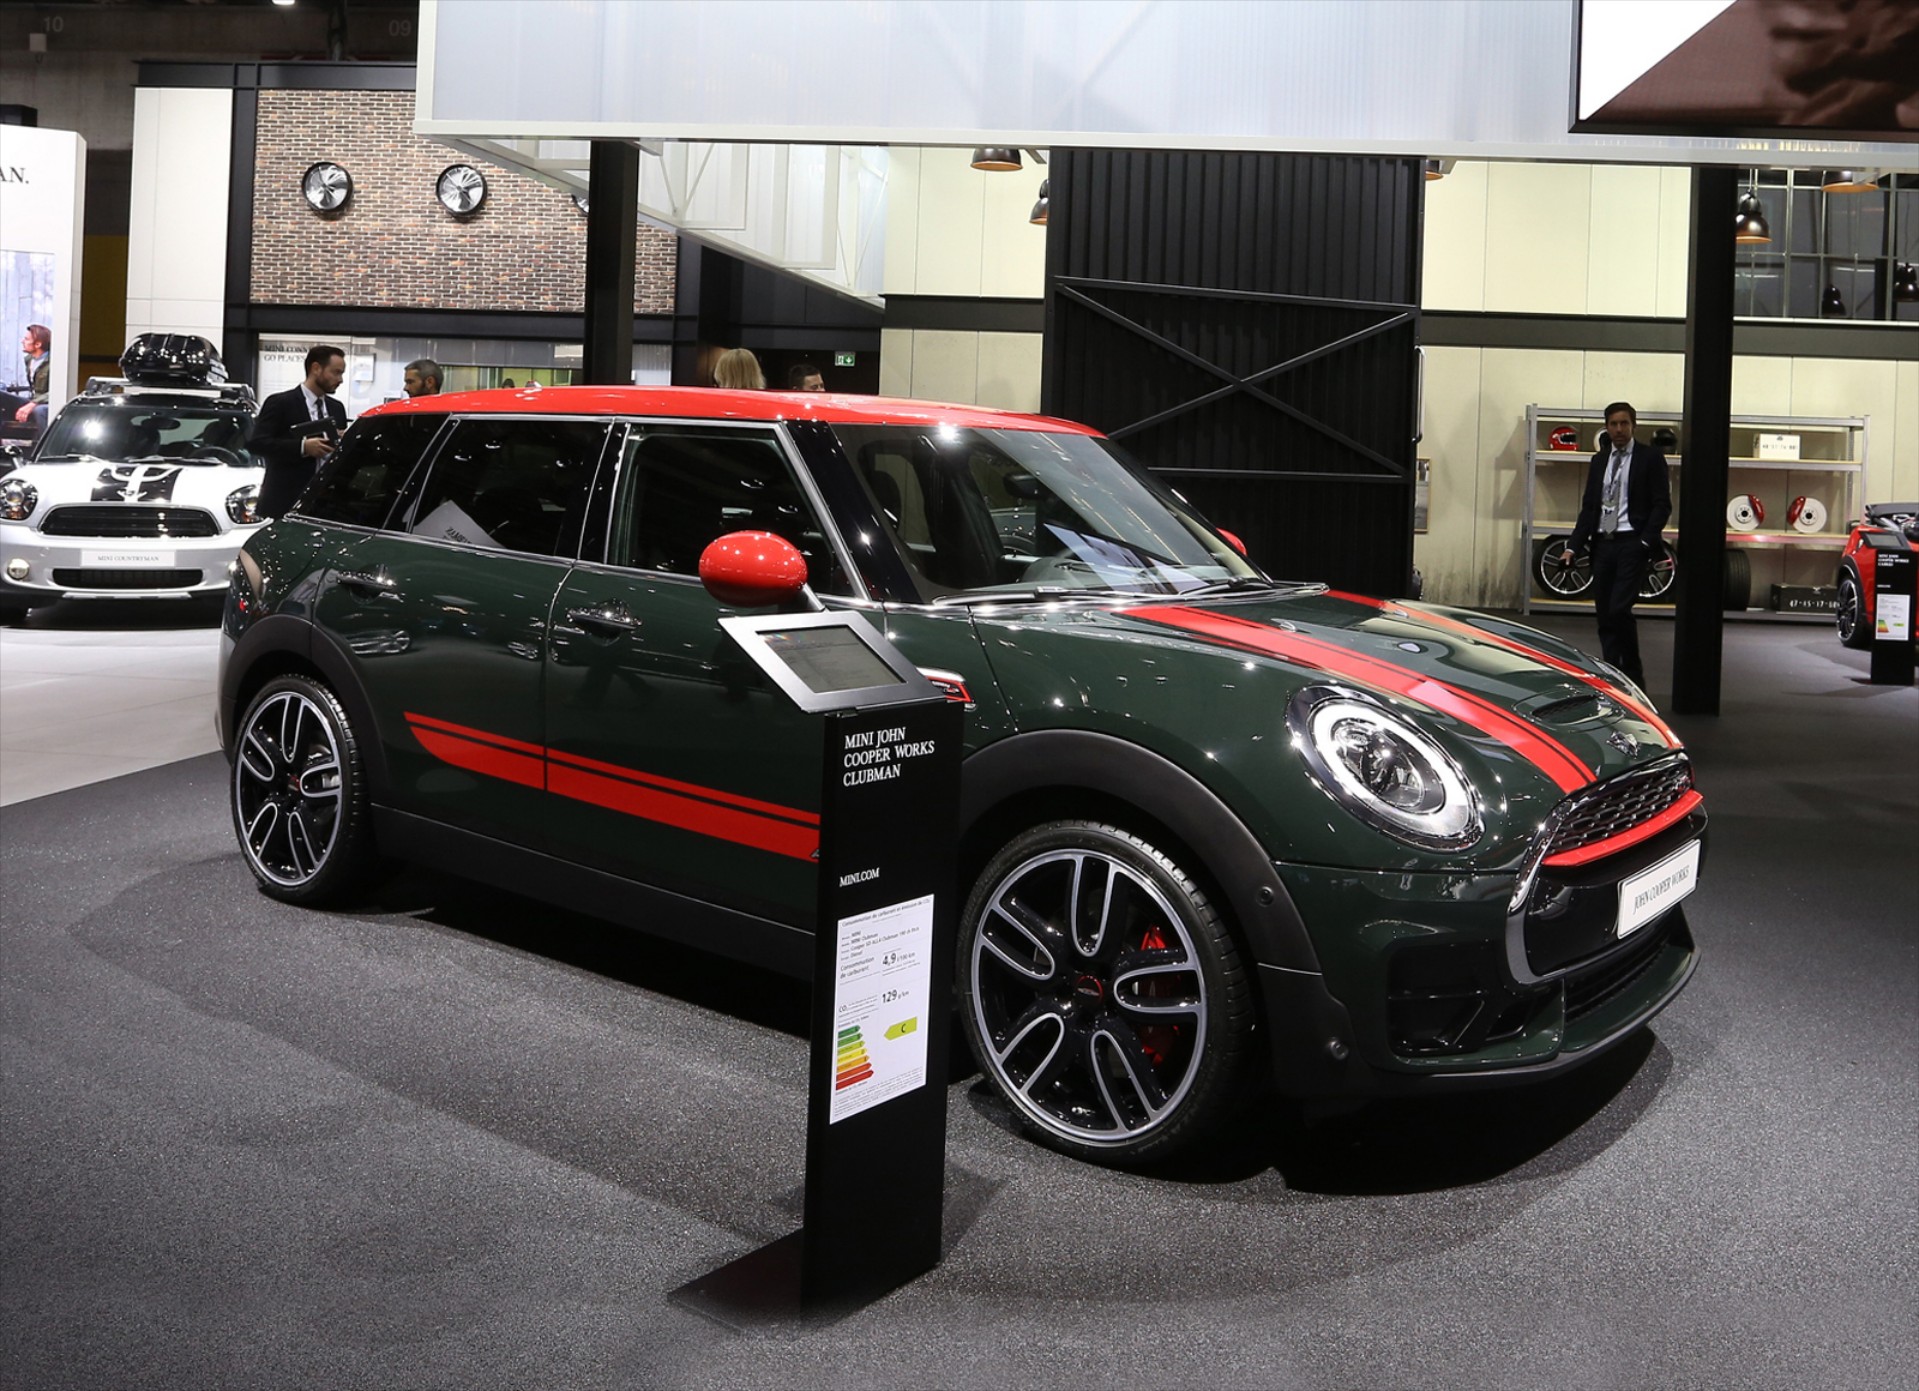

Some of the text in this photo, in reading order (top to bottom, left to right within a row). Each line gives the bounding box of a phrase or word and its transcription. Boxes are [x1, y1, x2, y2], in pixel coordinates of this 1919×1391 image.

[44, 16, 64, 32] 10
[389, 20, 411, 37] 09
[844, 726, 906, 749] MINI JOHN
[843, 740, 935, 768] COOPER WORKS
[843, 763, 901, 787] CLUBMAN
[839, 867, 880, 887] MINI.COM
[840, 957, 874, 972] Consommation
[882, 952, 896, 966] 4,9
[882, 989, 897, 1003] 129
[901, 1023, 907, 1033] C
